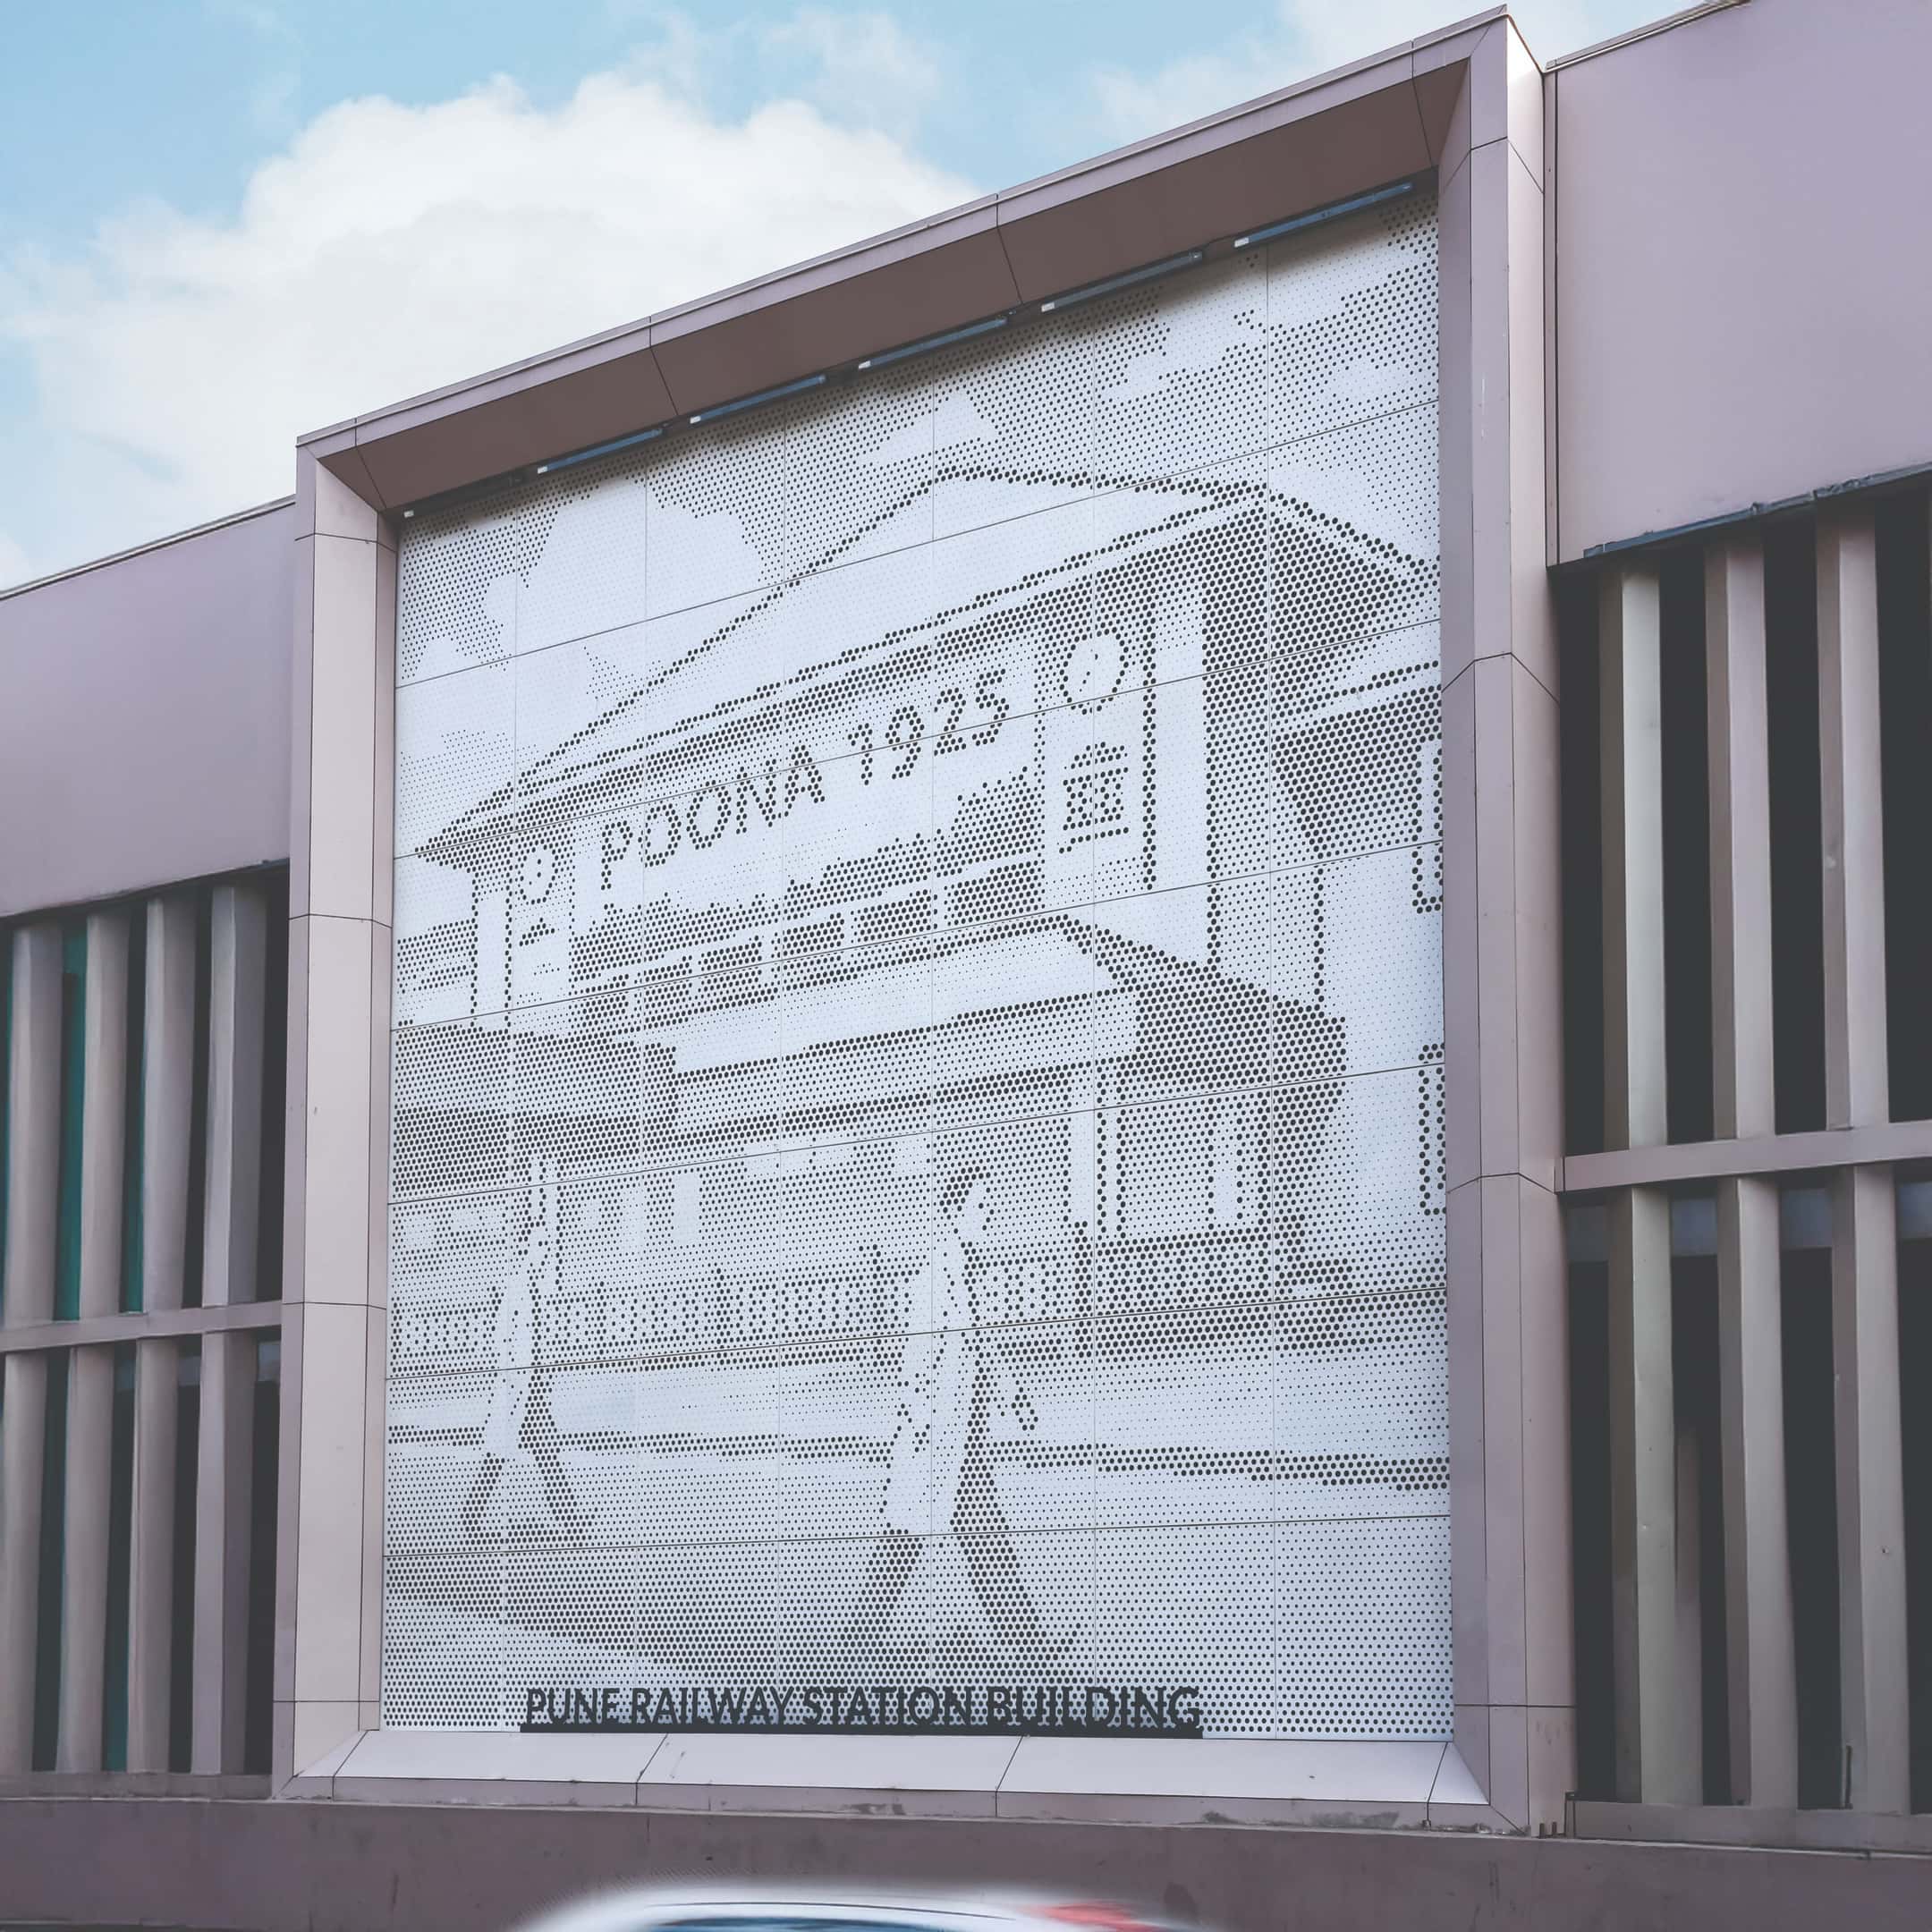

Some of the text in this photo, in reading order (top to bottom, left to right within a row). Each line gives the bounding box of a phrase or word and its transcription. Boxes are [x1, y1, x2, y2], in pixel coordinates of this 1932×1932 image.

[600, 668, 1010, 892] POONA 1925
[526, 1685, 1202, 1732] PUNE RAILWAY STATION BUILDING
